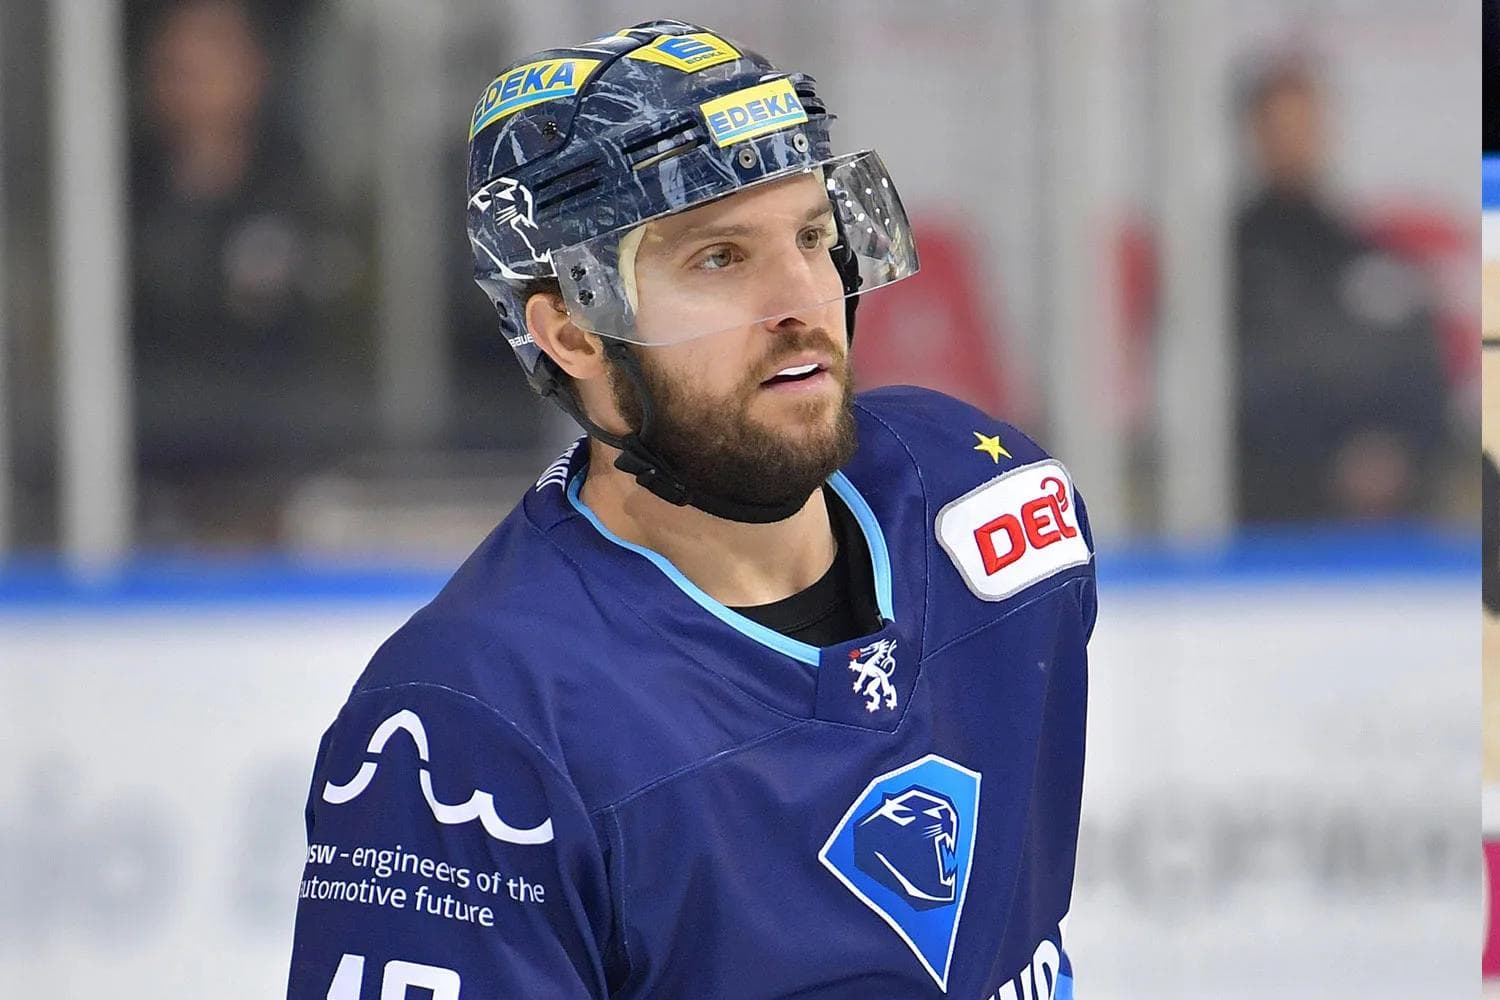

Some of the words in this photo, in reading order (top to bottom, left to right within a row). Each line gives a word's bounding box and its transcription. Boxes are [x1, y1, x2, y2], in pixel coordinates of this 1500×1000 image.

[475, 61, 576, 123] EDEKA
[711, 92, 801, 134] EDEKA
[301, 876, 407, 908] utomotive
[415, 886, 495, 927] future
[476, 871, 501, 895] of
[507, 876, 545, 903] the
